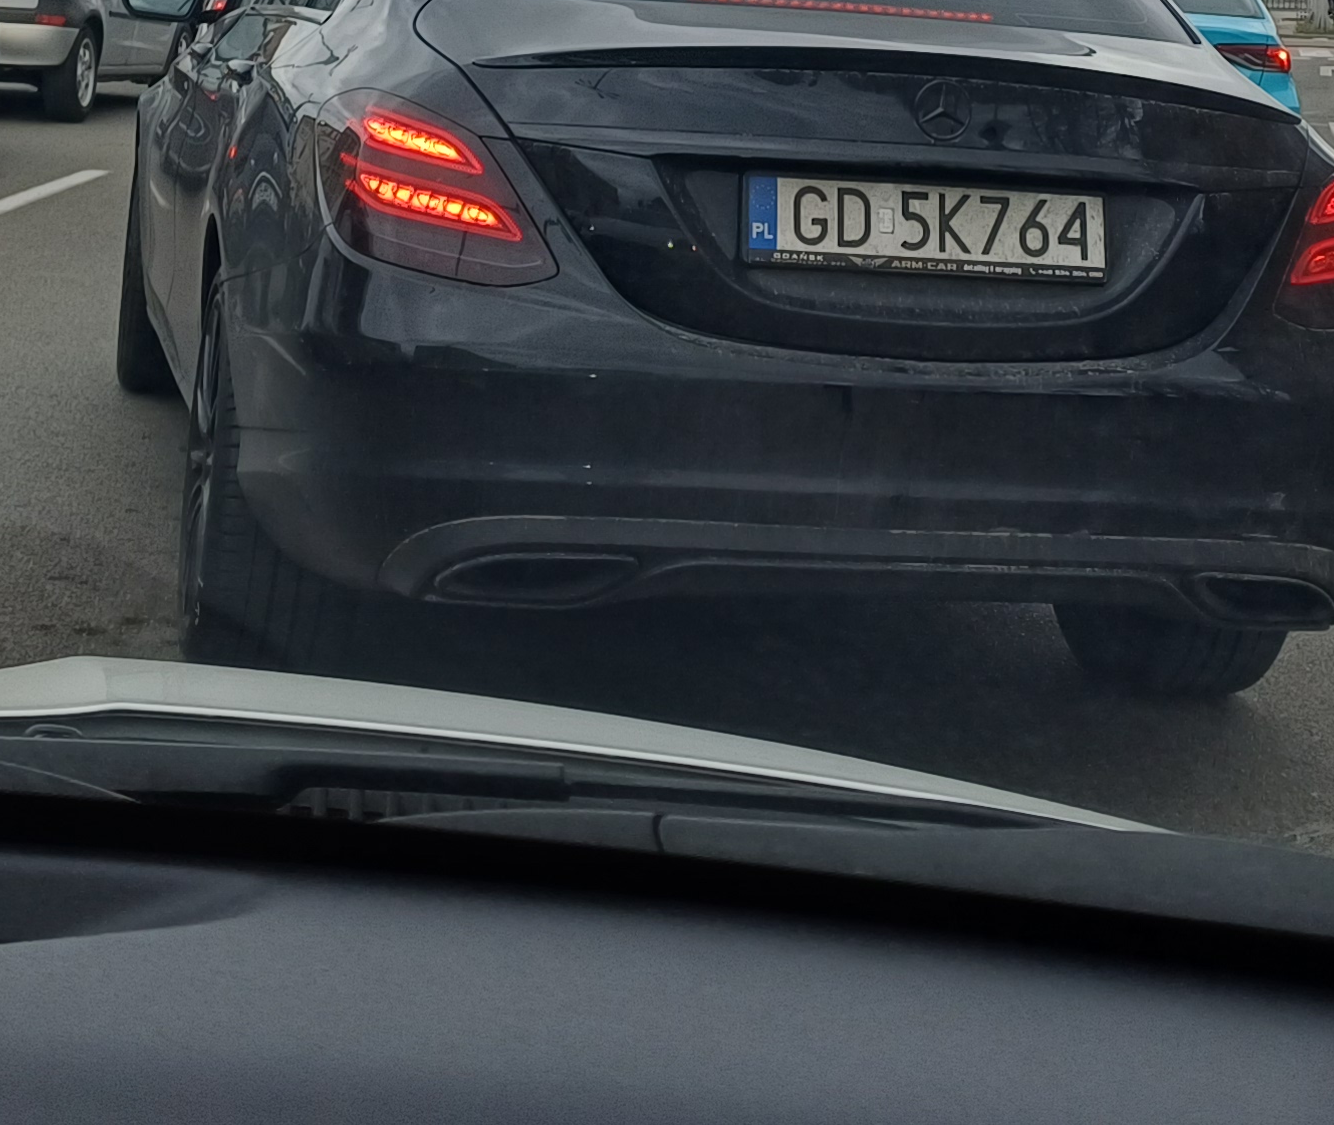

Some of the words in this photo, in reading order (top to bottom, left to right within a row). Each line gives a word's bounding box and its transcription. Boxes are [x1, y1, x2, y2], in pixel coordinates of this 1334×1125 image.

[752, 222, 774, 239] PL
[793, 185, 871, 248] GD
[900, 190, 1089, 261] 5K764
